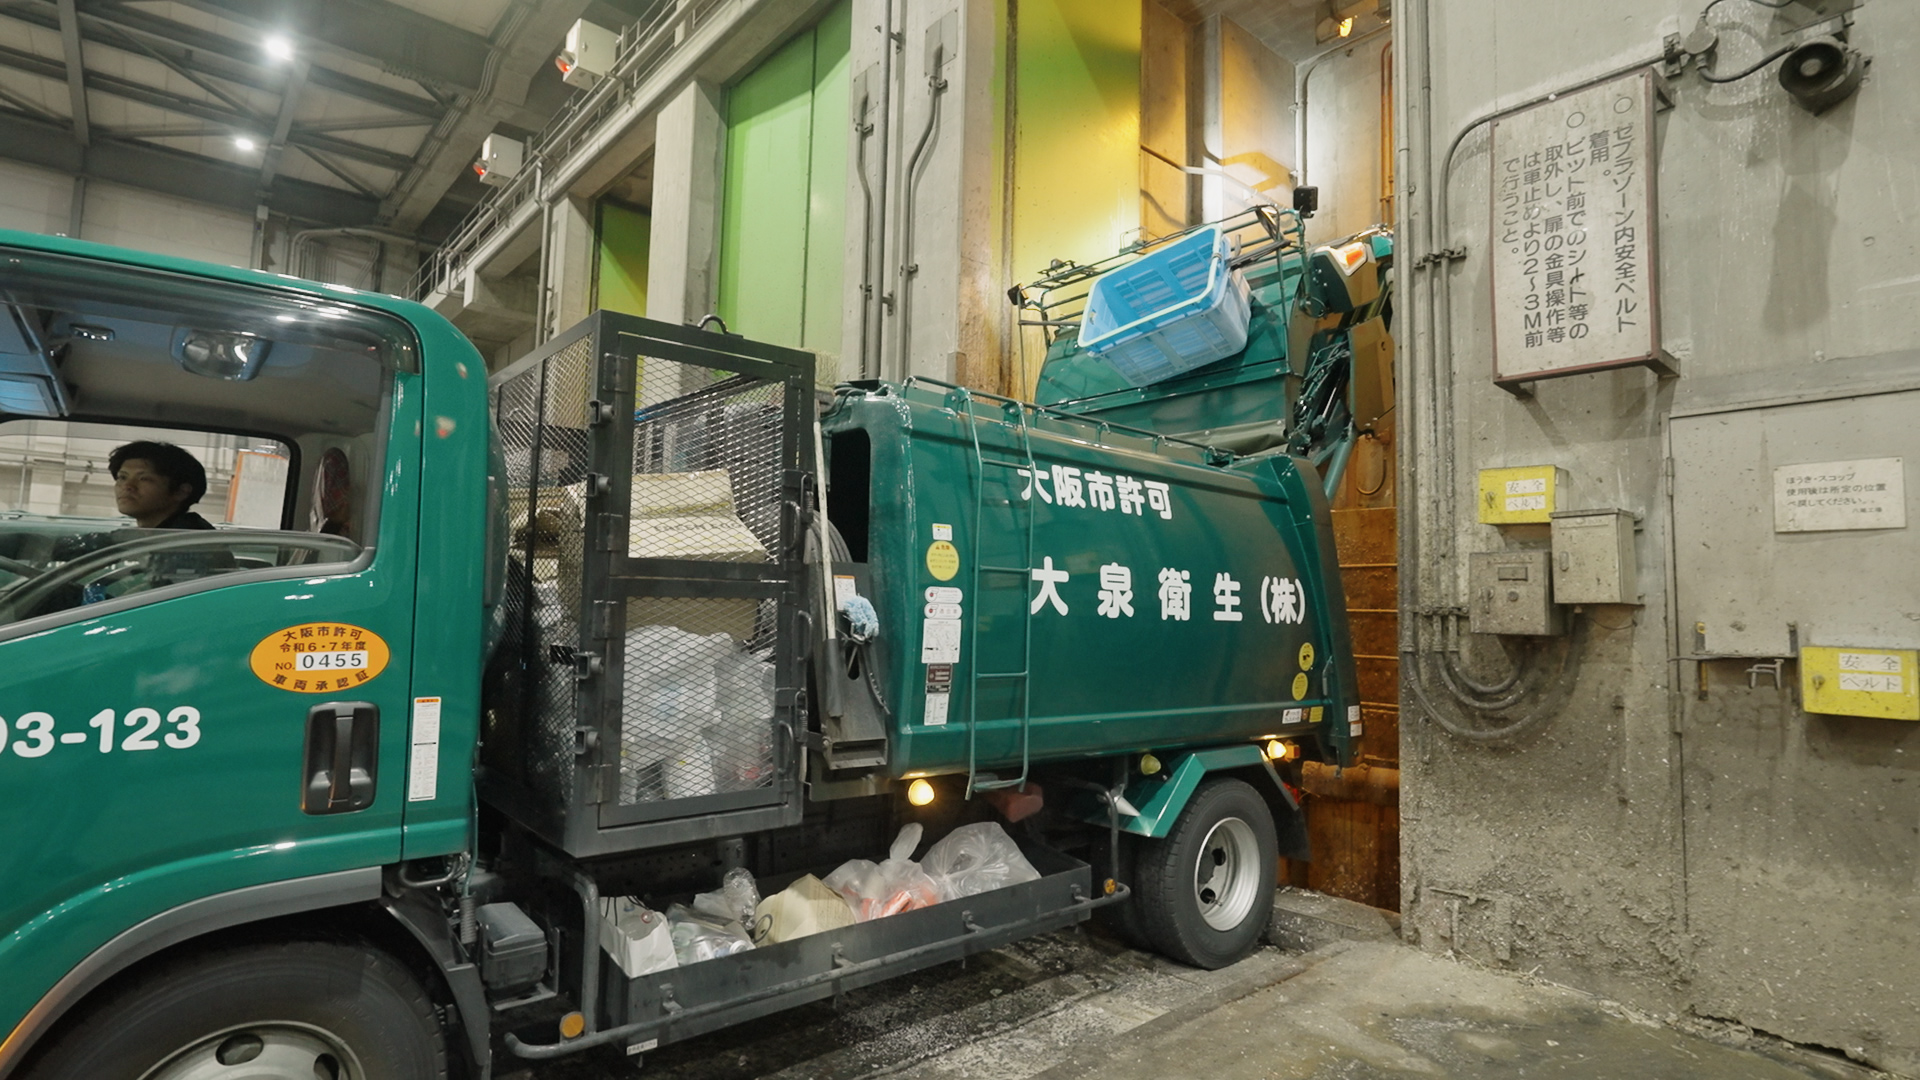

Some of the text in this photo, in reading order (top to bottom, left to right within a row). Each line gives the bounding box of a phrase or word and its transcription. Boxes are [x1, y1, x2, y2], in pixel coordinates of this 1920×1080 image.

[1017, 461, 1173, 520] 大阪市許可
[283, 626, 363, 642] 大阪市許可
[302, 653, 362, 668] 0455
[272, 669, 370, 691] 車両承認証
[0, 705, 201, 758] 3-123
